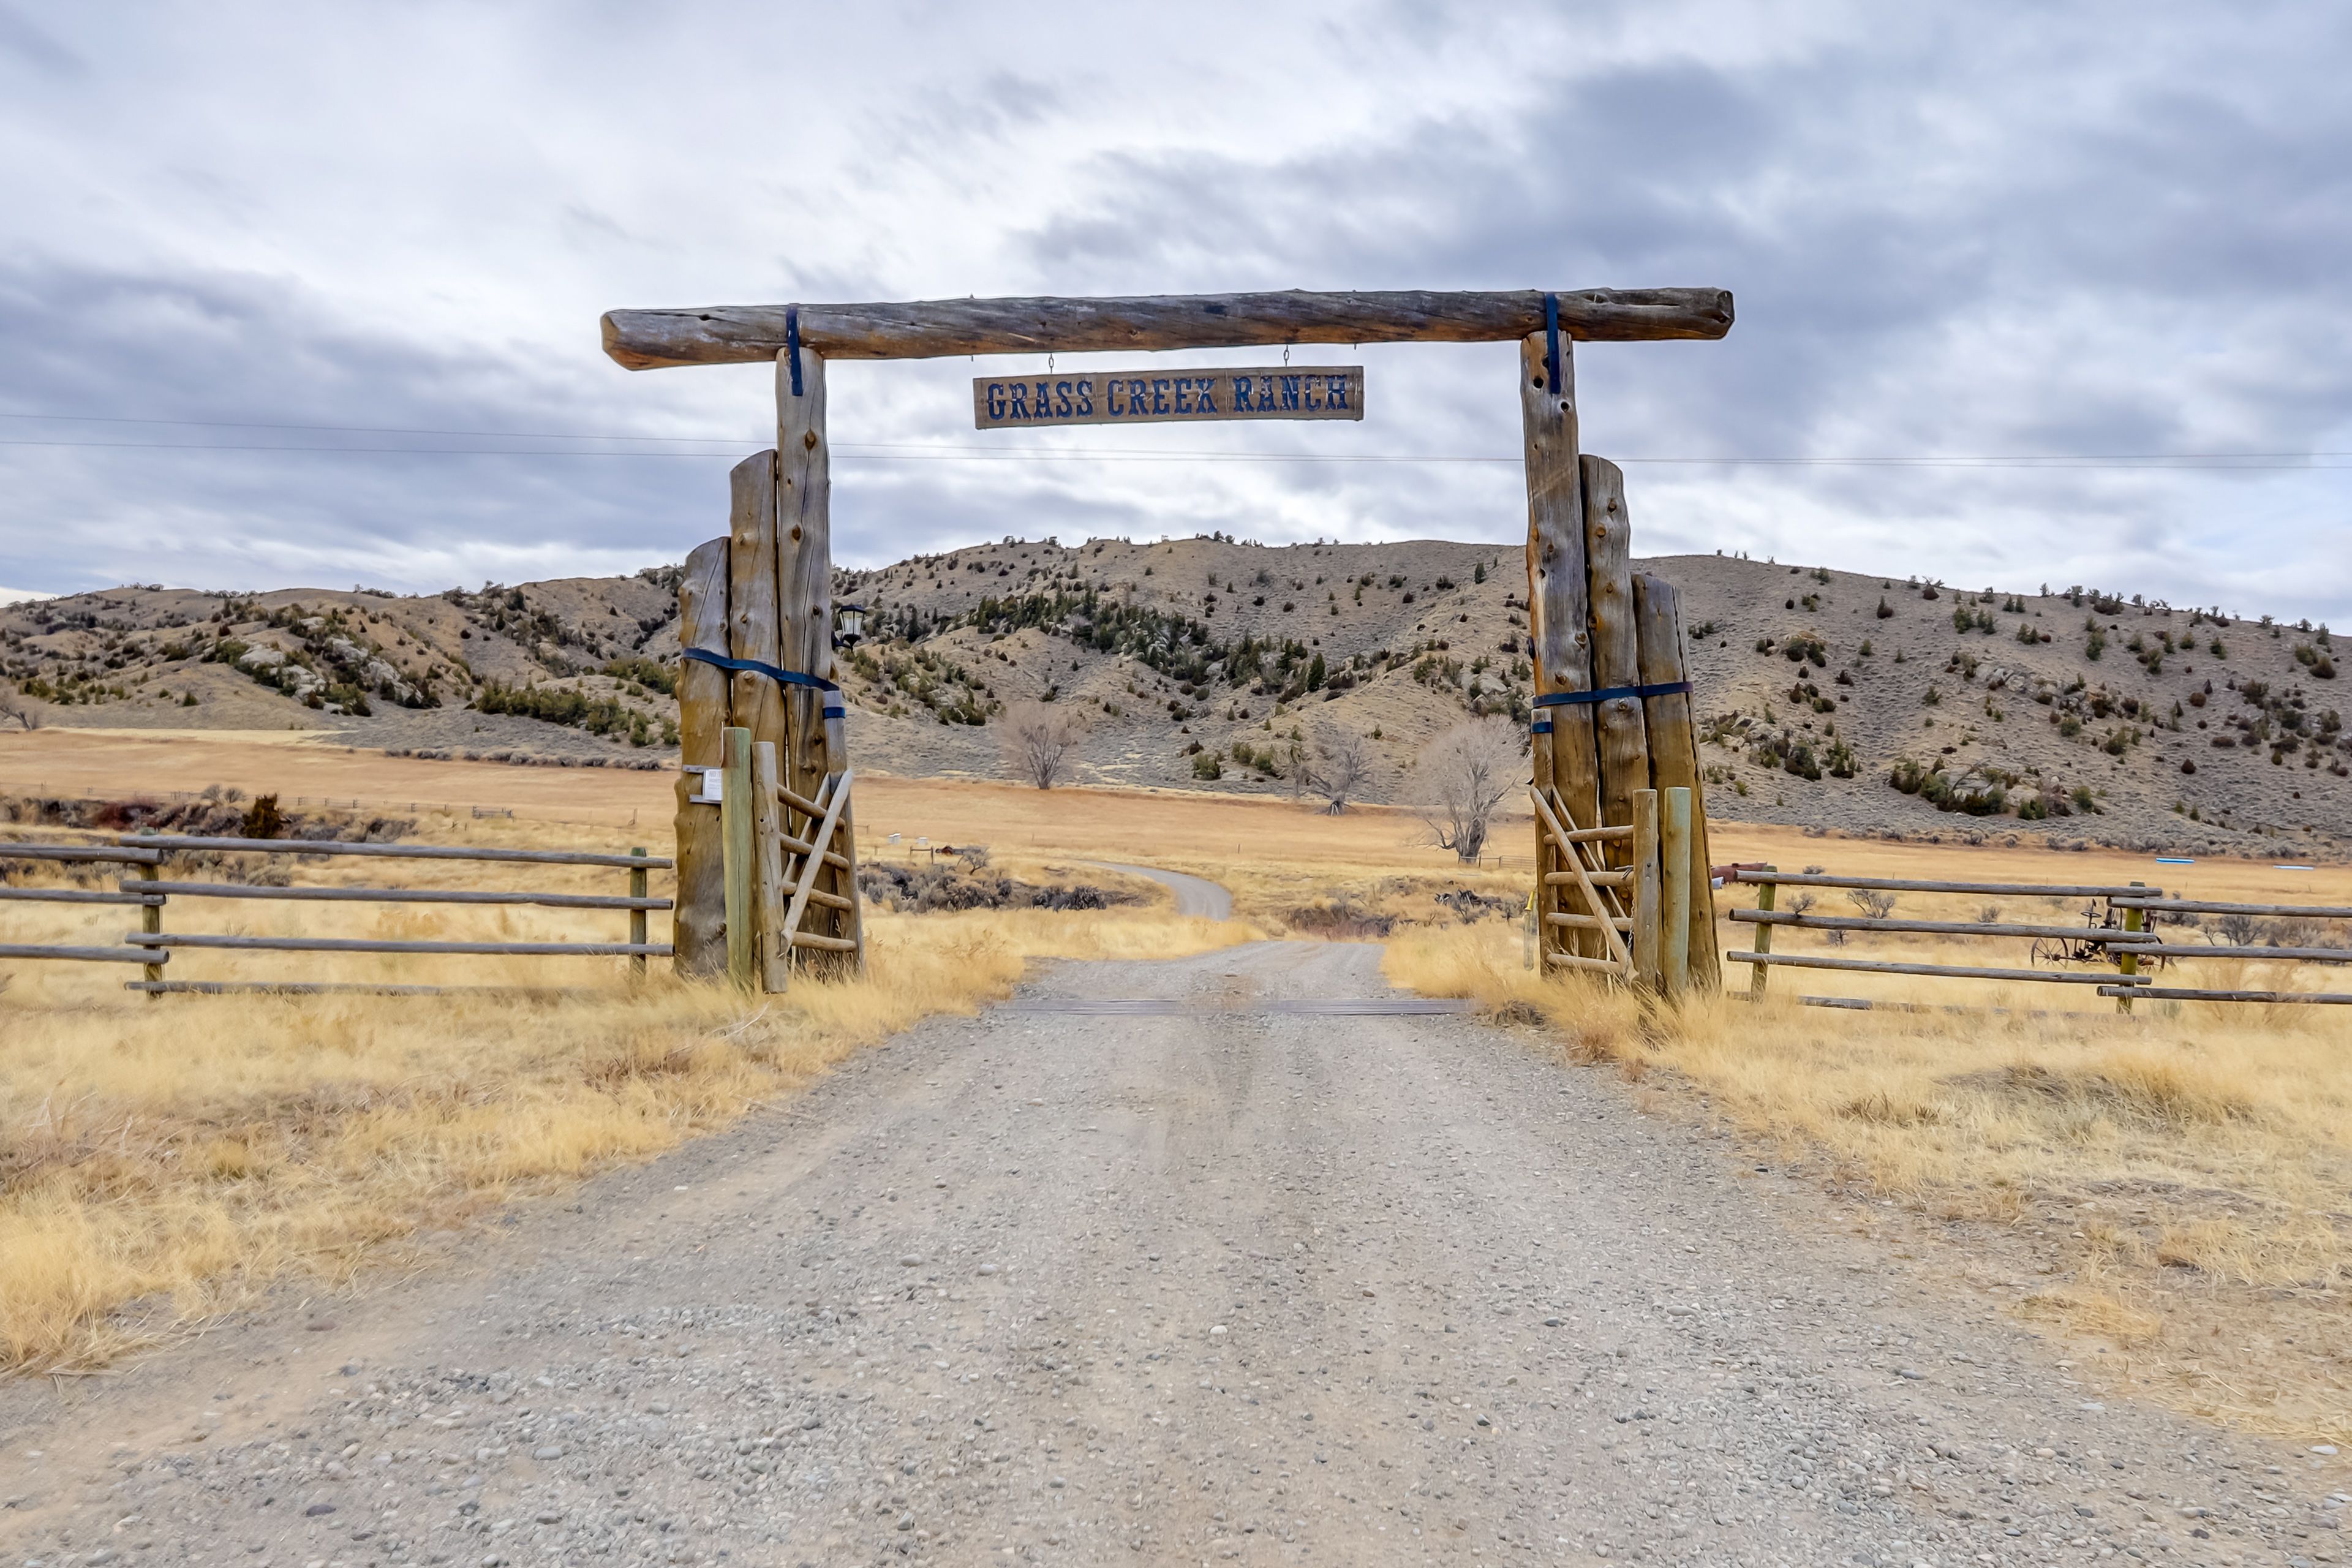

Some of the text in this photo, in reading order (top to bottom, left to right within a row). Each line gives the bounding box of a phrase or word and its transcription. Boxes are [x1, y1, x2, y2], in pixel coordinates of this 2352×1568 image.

[987, 374, 1348, 421] GRASS CREEK RANCH
